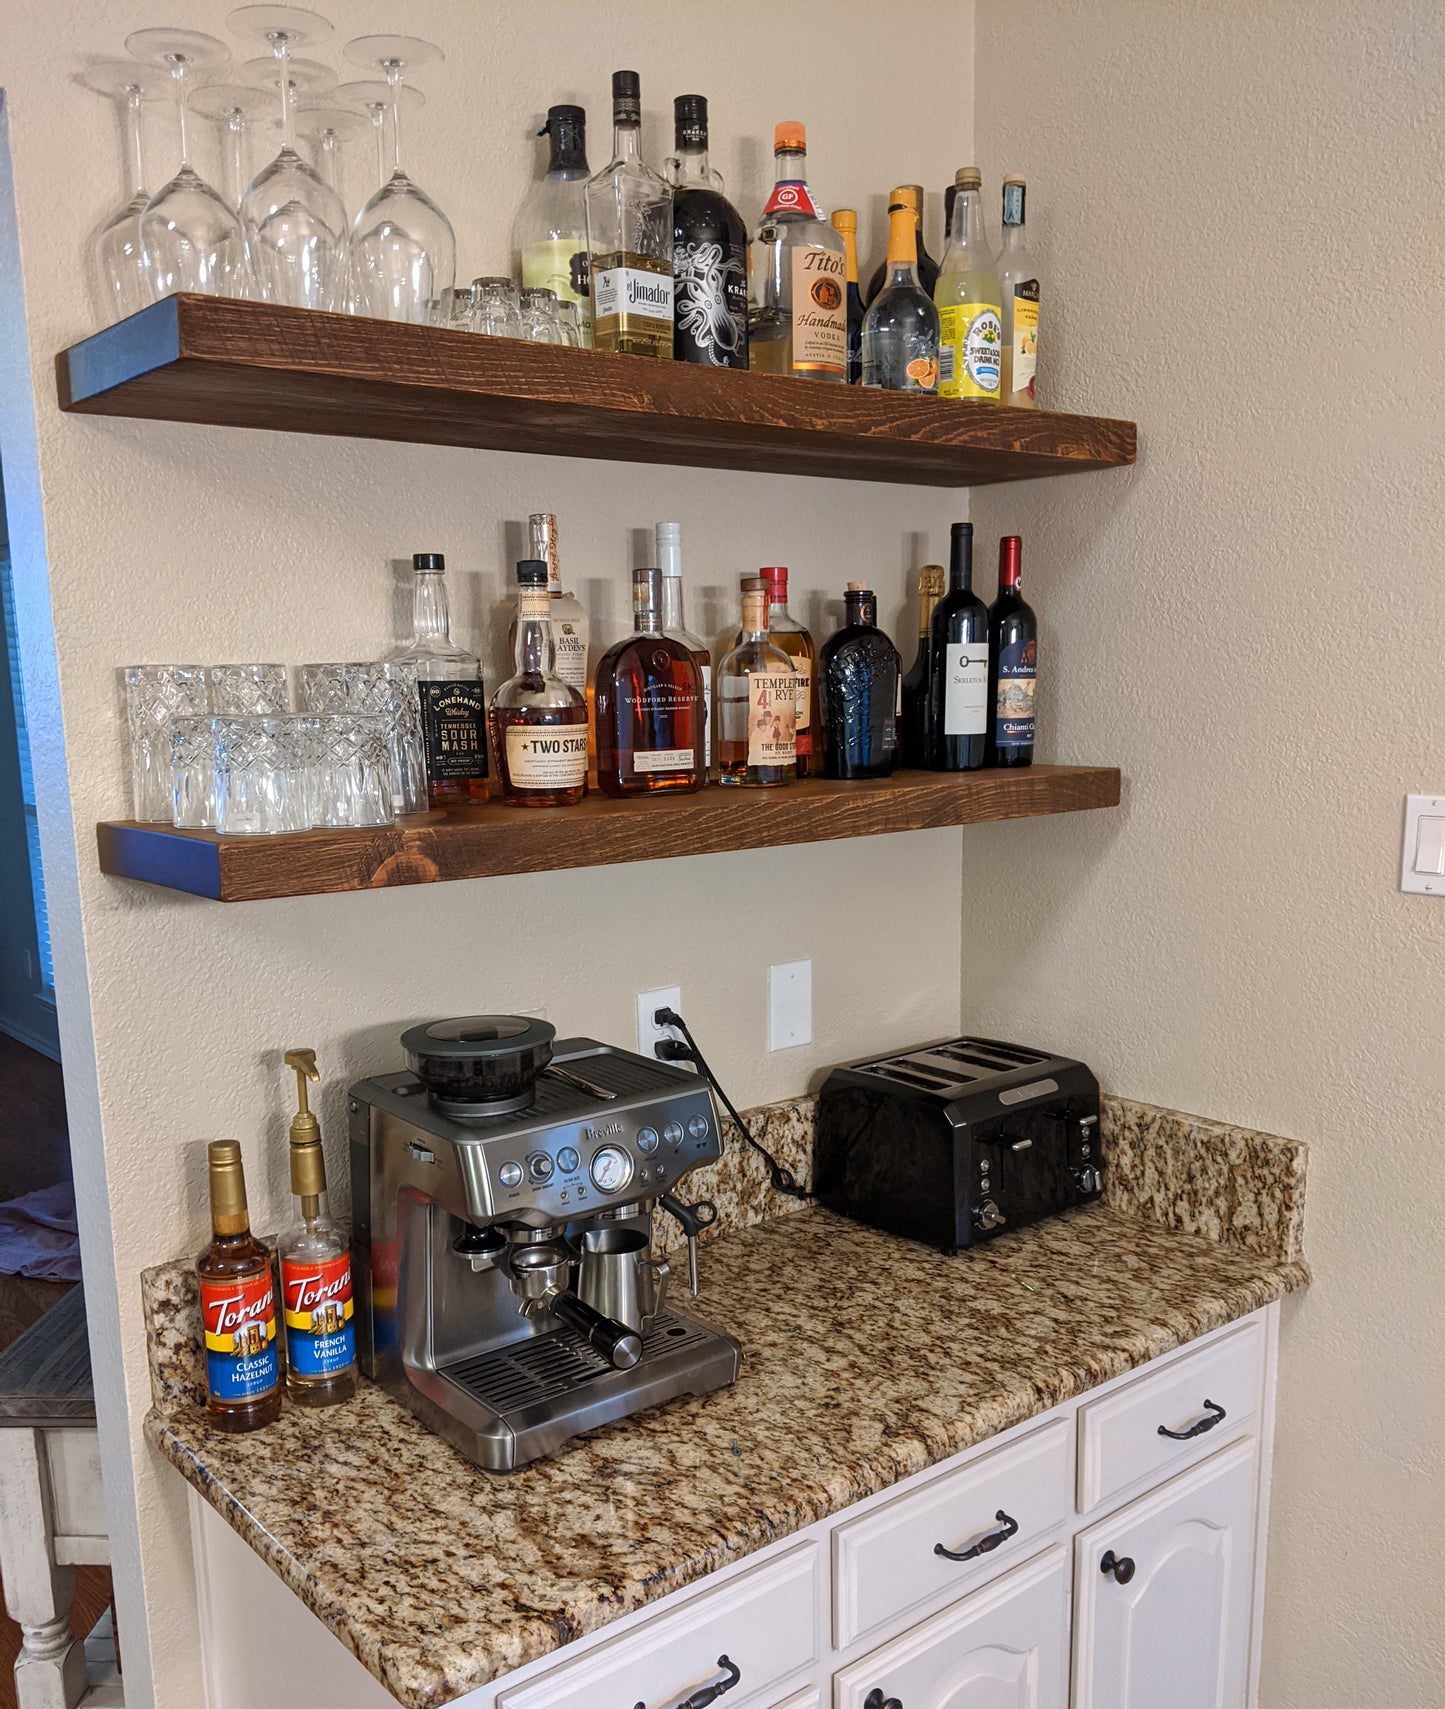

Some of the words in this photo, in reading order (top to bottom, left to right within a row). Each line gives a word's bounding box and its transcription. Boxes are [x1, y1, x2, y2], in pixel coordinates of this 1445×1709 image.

[804, 251, 845, 276] Tito's
[629, 278, 670, 305] Jimador
[815, 331, 840, 341] VODKA
[973, 320, 1000, 340] ROSE'S
[974, 356, 992, 364] DRINK
[954, 675, 982, 684] SKELETON
[624, 696, 666, 704] WOODFORD
[668, 695, 700, 703] RESERVE
[757, 690, 769, 710] 4
[775, 690, 794, 701] RYE
[433, 696, 481, 712] LONEHAND
[1003, 722, 1029, 731] Chianti
[441, 729, 478, 741] SOUR
[442, 740, 478, 751] MASH
[530, 740, 560, 754] TWO
[761, 743, 773, 752] THE
[775, 743, 788, 751] GOOD
[585, 1122, 624, 1140] Breville
[314, 1334, 345, 1349] FRENCH
[313, 1344, 347, 1359] VANILLA
[236, 1355, 269, 1372] CLASSIC
[231, 1363, 273, 1383] HAZELNUT
